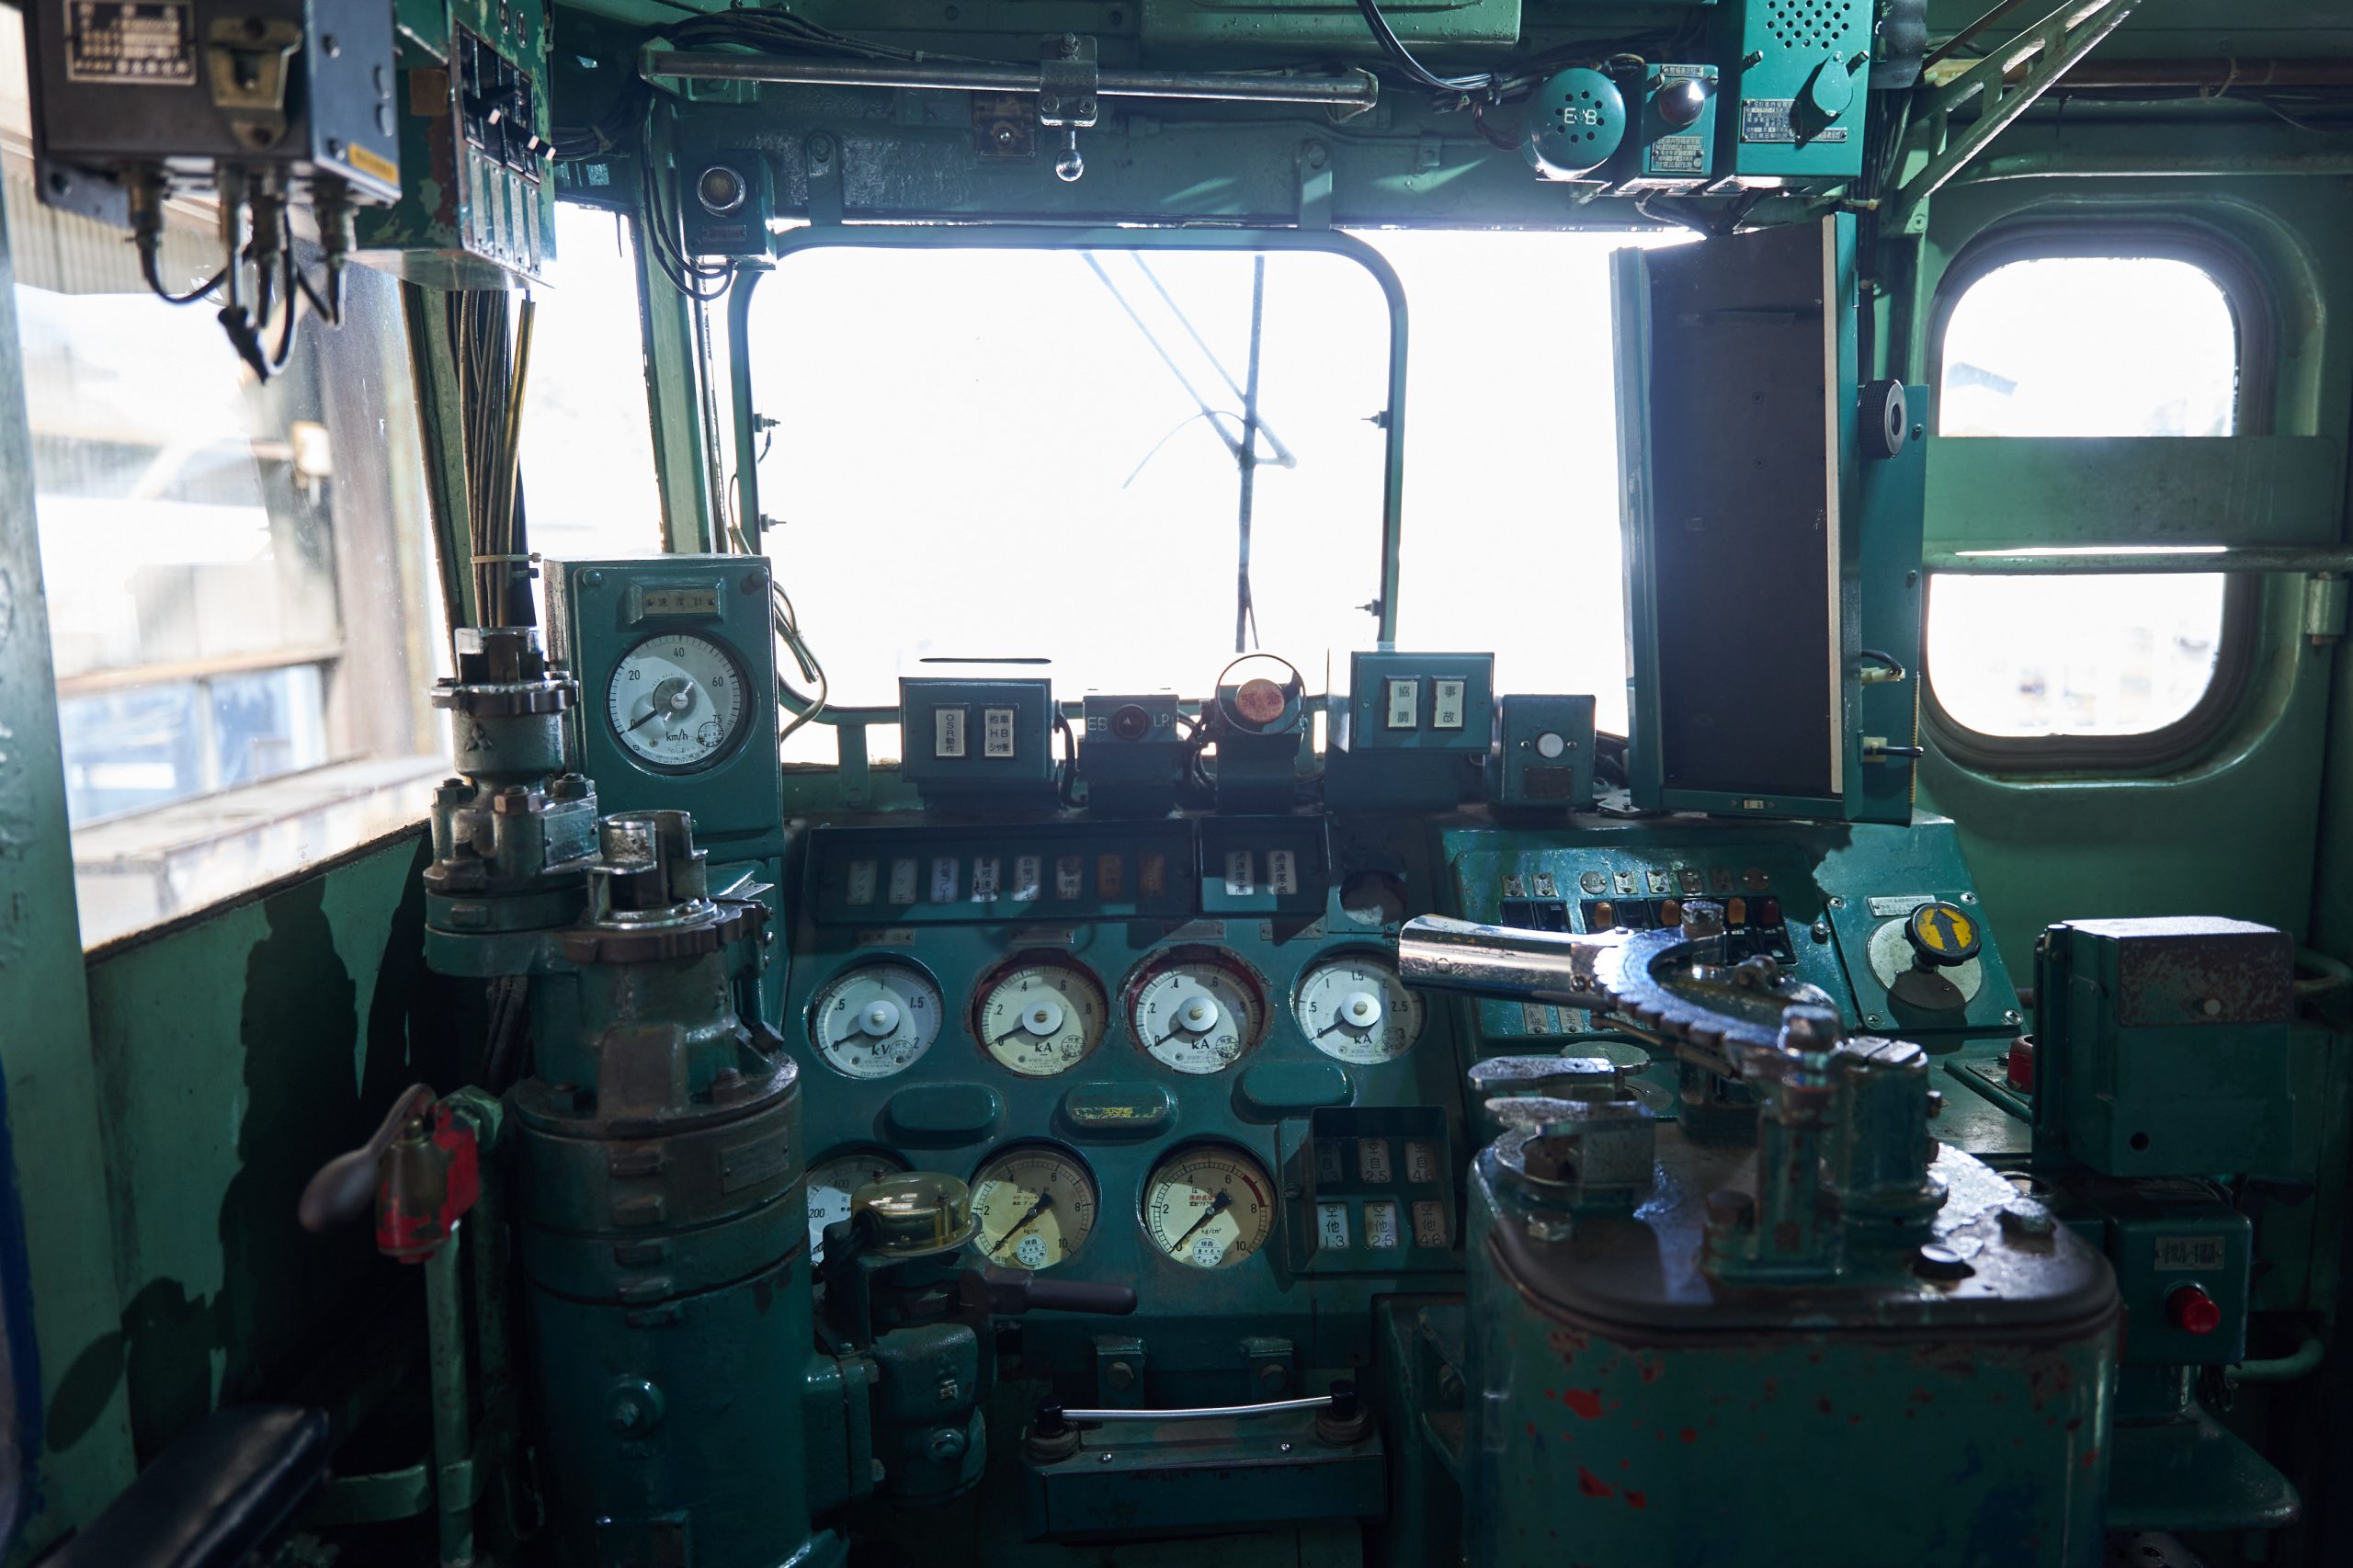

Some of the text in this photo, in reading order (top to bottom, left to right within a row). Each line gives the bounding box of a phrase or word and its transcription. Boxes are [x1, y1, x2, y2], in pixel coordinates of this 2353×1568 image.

[658, 596, 706, 608] 速度計
[674, 647, 684, 658] 40
[629, 670, 641, 680] 20
[712, 676, 723, 687] 60
[1397, 685, 1410, 723] 協調
[1443, 686, 1457, 722] 事故
[713, 714, 722, 724] 75
[990, 715, 1008, 724] 他車
[1087, 716, 1108, 732] EB
[666, 729, 688, 743] km/h
[990, 729, 1008, 738] HB
[1210, 976, 1218, 987] .6
[1351, 971, 1364, 981] 1.5
[1020, 981, 1027, 992] .4
[1059, 980, 1066, 991] .6
[1171, 977, 1178, 989] .4
[1381, 978, 1389, 989] 2
[835, 998, 846, 1010] .5
[910, 997, 924, 1009] 1.5
[1084, 1003, 1091, 1014] .8
[1147, 1003, 1156, 1014] .2
[1309, 1001, 1317, 1013] .5
[1391, 1001, 1408, 1012] 2.5
[994, 1005, 1003, 1016] .2
[914, 1037, 920, 1050] 2
[1191, 1039, 1210, 1050] kA
[1354, 1034, 1372, 1045] kA
[871, 1044, 890, 1056] kV
[1035, 1042, 1052, 1052] kA
[1051, 1172, 1057, 1182] 6
[1188, 1174, 1193, 1184] 4
[1225, 1174, 1232, 1185] 6
[983, 1205, 990, 1216] 2
[1074, 1202, 1081, 1212] 8
[1163, 1203, 1169, 1214] 2
[1250, 1203, 1257, 1214] 8
[809, 1209, 825, 1219] 200
[1058, 1238, 1068, 1249] 10
[1235, 1241, 1246, 1251] 10
